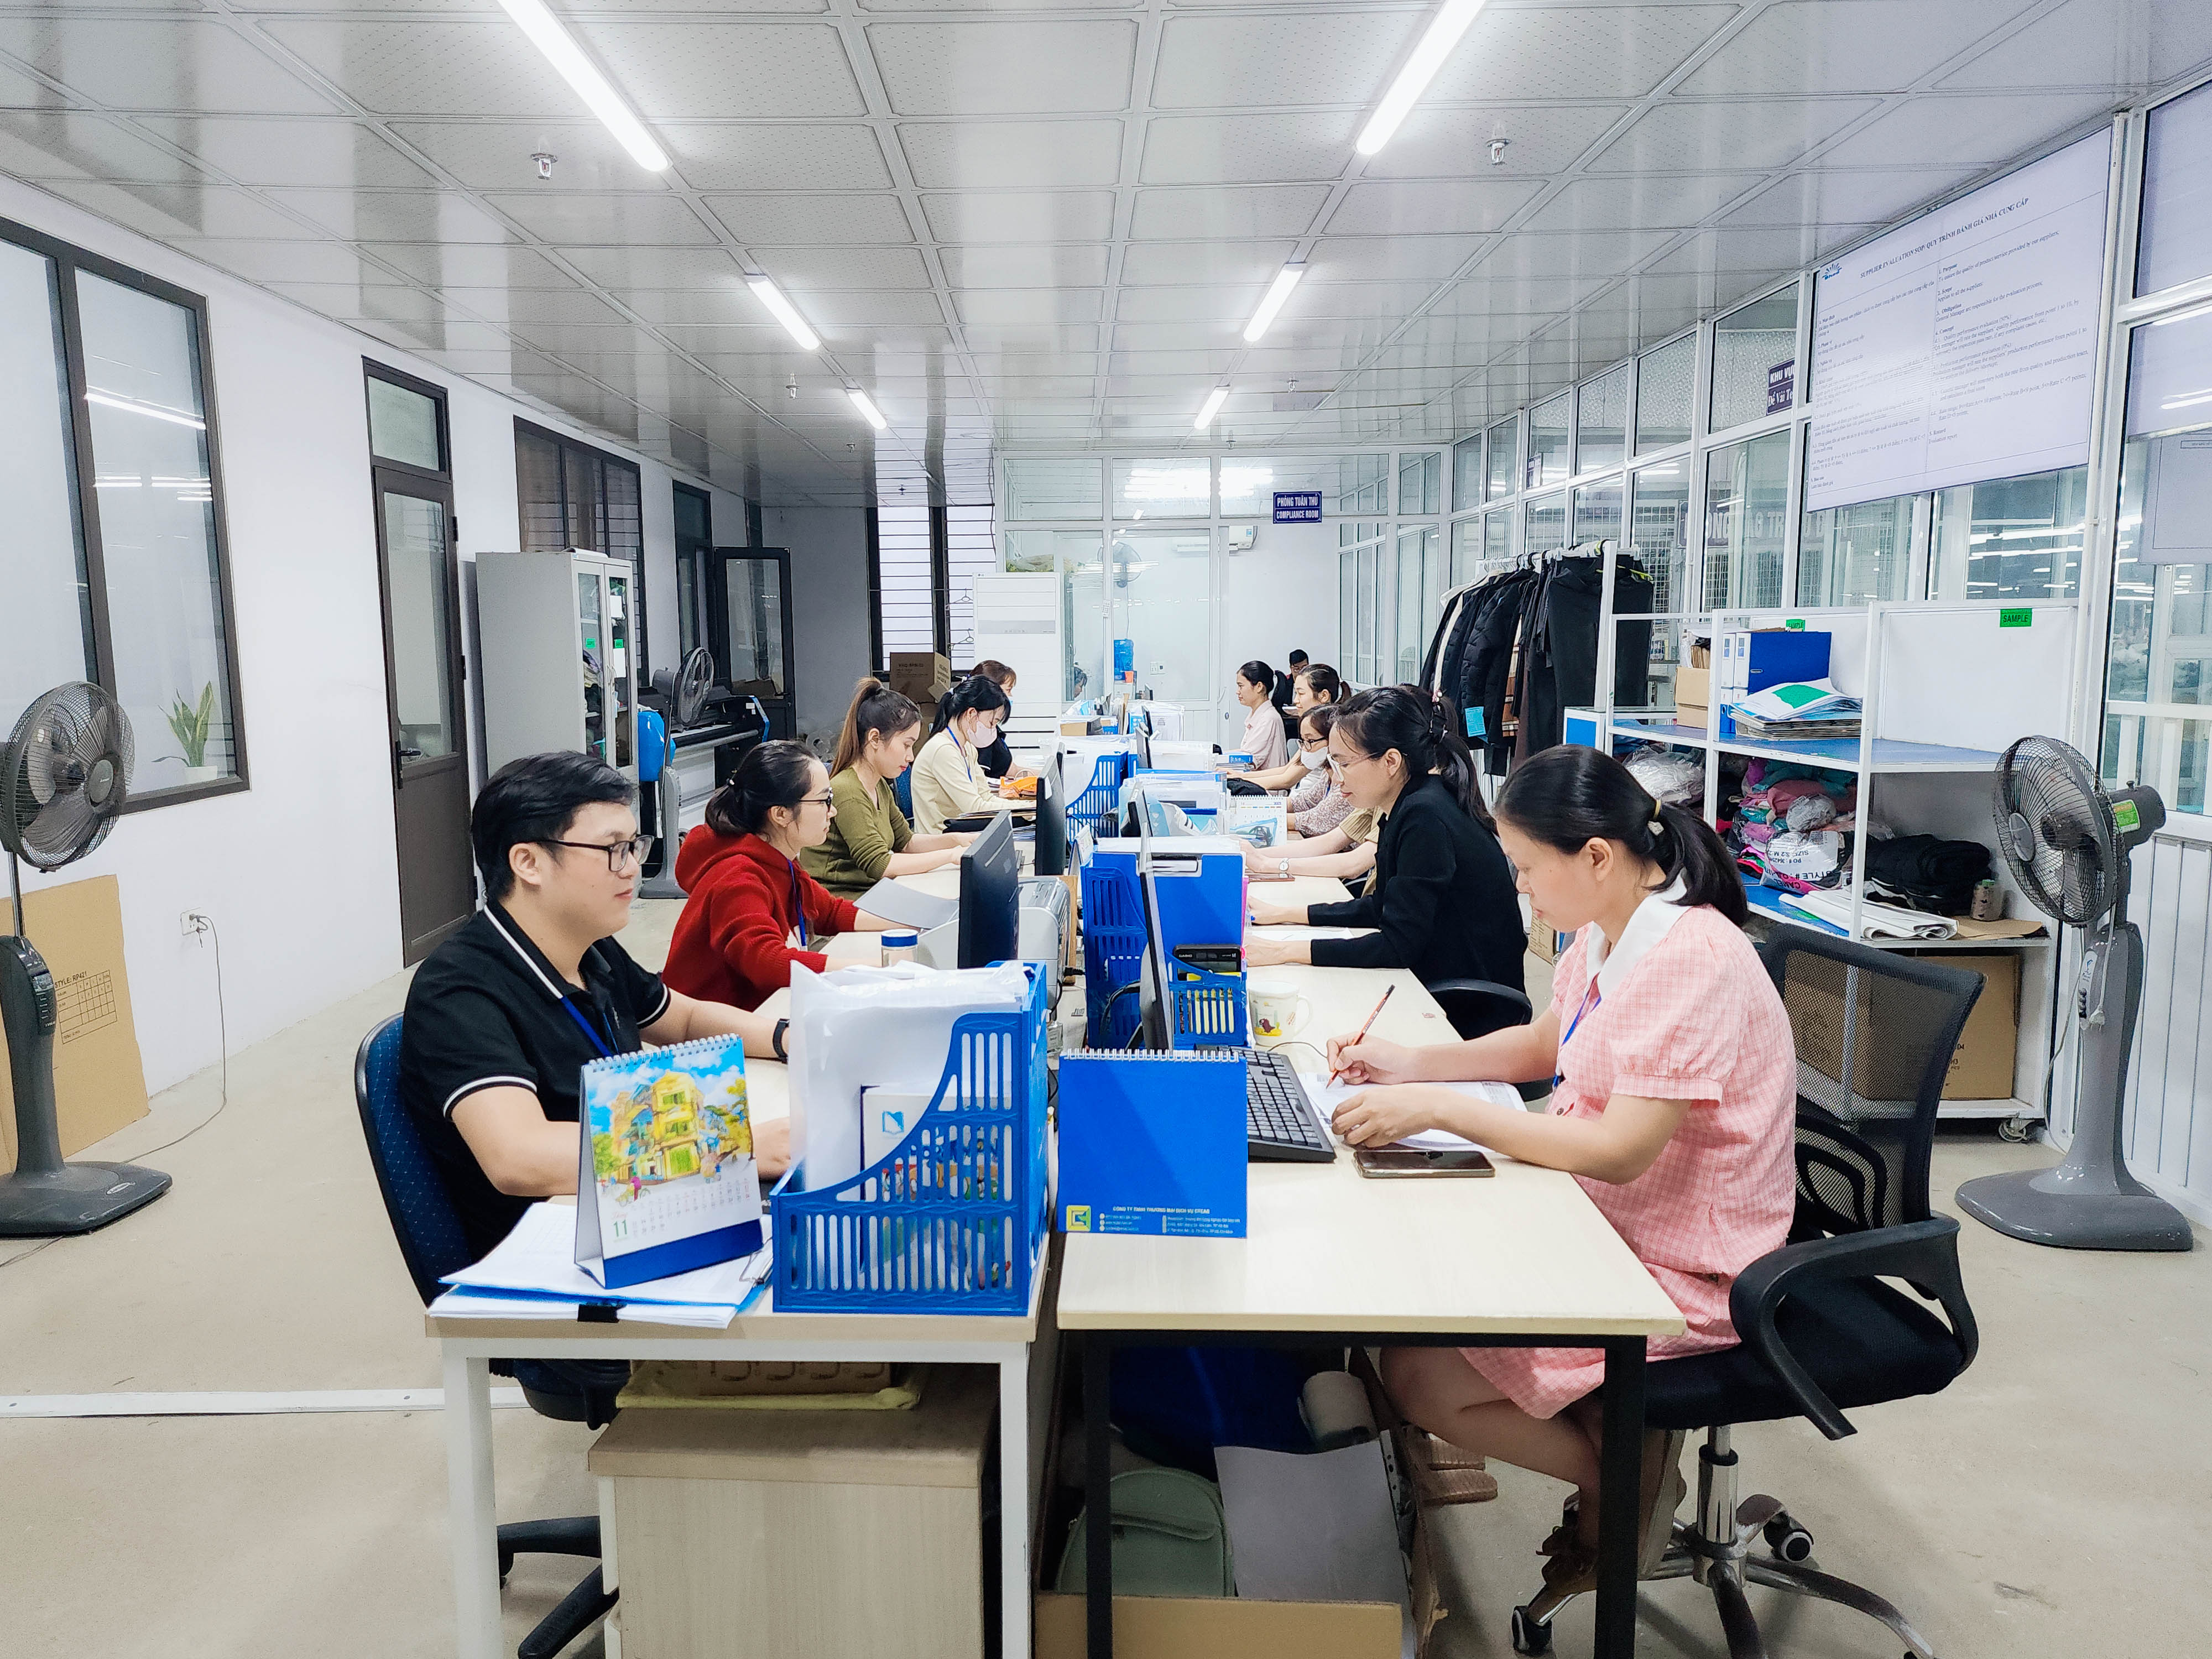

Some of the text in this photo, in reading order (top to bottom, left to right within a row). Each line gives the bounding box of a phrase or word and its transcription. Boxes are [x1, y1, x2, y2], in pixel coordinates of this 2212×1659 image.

[1860, 263, 1882, 279] SUPPLIER
[1882, 249, 1914, 269] EVALUATION
[1770, 369, 1783, 384] KHU
[1277, 495, 1293, 507] PHÒNG
[1276, 510, 1319, 519] COMPLIANCE ROOM
[2003, 614, 2028, 623] SAMPLE
[54, 971, 87, 988] STYLE: RP421
[613, 1219, 628, 1237] 11
